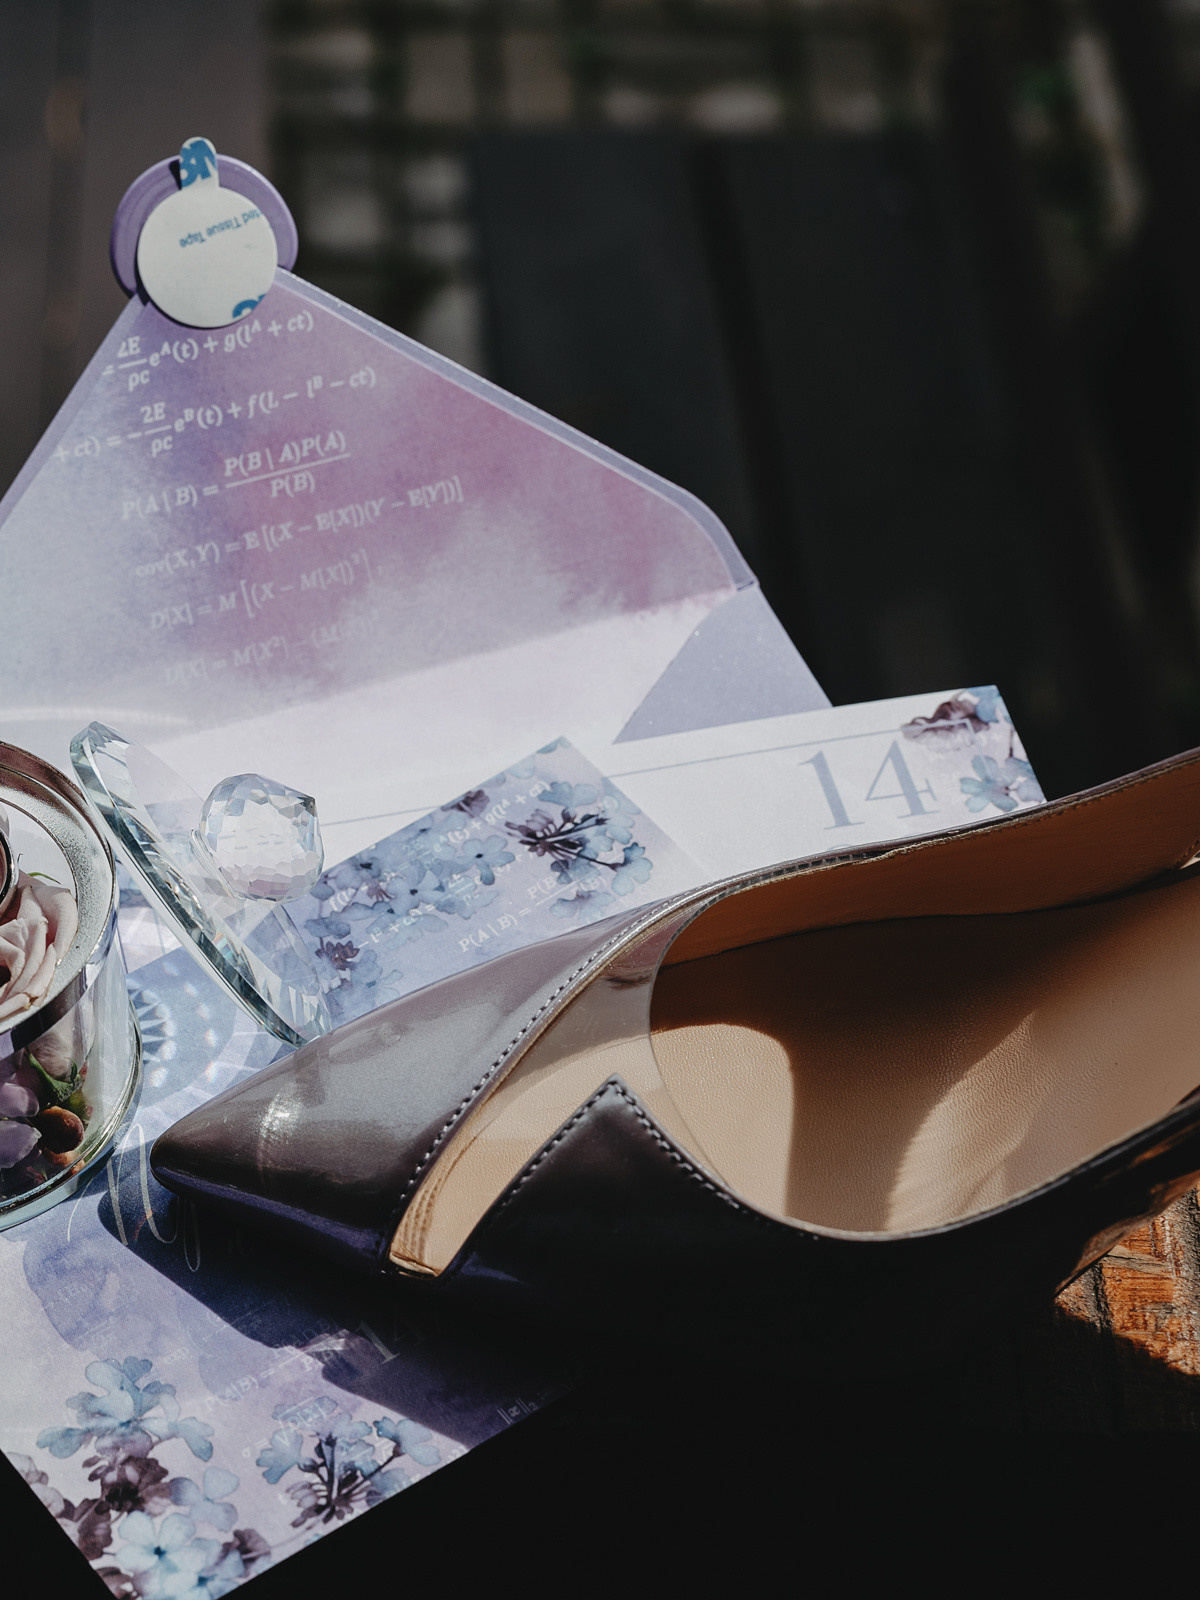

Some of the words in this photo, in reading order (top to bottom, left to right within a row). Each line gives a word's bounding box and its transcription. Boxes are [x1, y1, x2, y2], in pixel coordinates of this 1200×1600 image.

[206, 217, 242, 237] Tissue
[179, 231, 206, 248] Tape
[797, 740, 941, 831] 14
